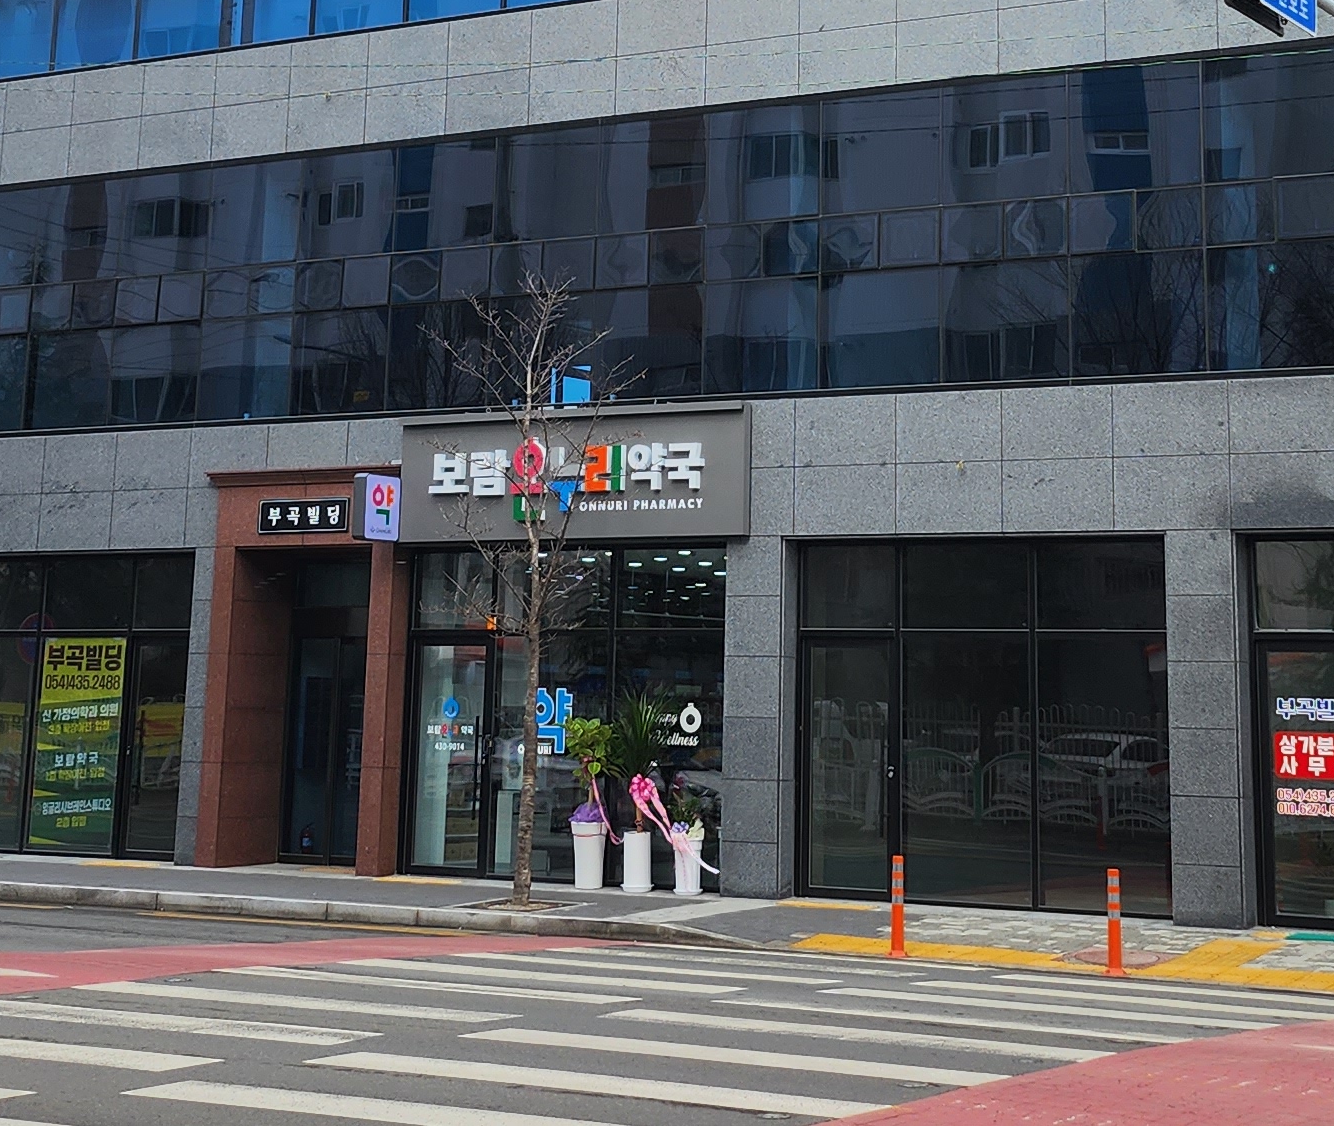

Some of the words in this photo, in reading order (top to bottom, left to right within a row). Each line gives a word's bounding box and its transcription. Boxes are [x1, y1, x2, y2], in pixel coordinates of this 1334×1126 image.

[267, 504, 343, 527] 부곡빌딩
[372, 483, 395, 526] 약
[579, 501, 628, 512] ONNURI
[633, 497, 704, 510] PHARMACY
[47, 644, 122, 671] 부곡빌딩
[45, 674, 121, 690] 054)435.2488
